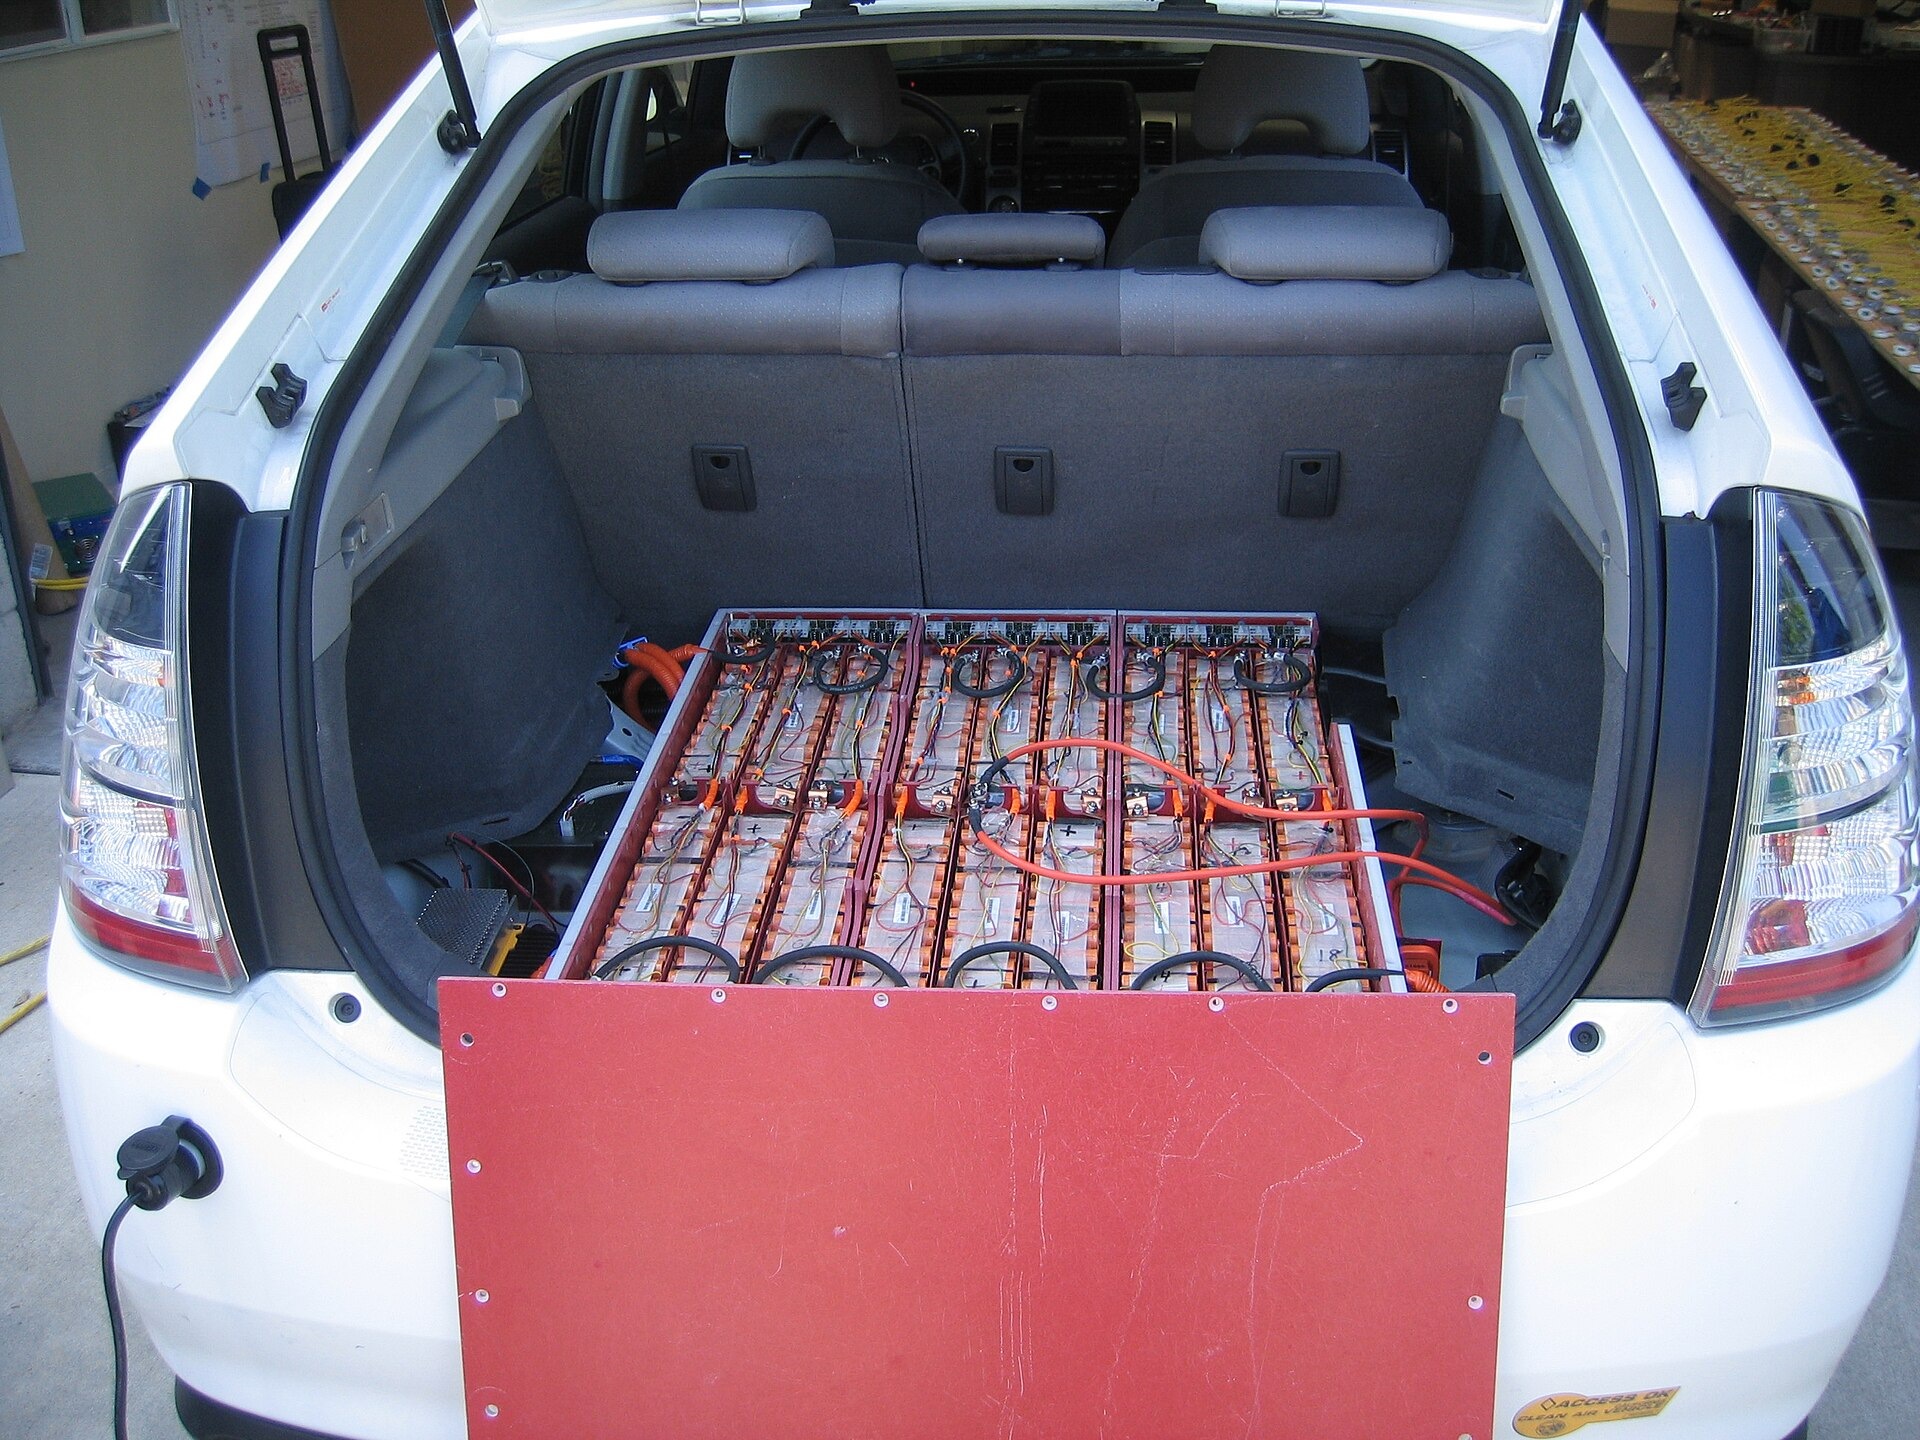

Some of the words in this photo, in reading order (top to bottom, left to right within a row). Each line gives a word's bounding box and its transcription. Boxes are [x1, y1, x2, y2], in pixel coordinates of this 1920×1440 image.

[1555, 1394, 1638, 1408] ACCESS
[1643, 1390, 1671, 1400] OK
[1517, 1412, 1568, 1422] CLEAN
[1571, 1409, 1598, 1418] AIR
